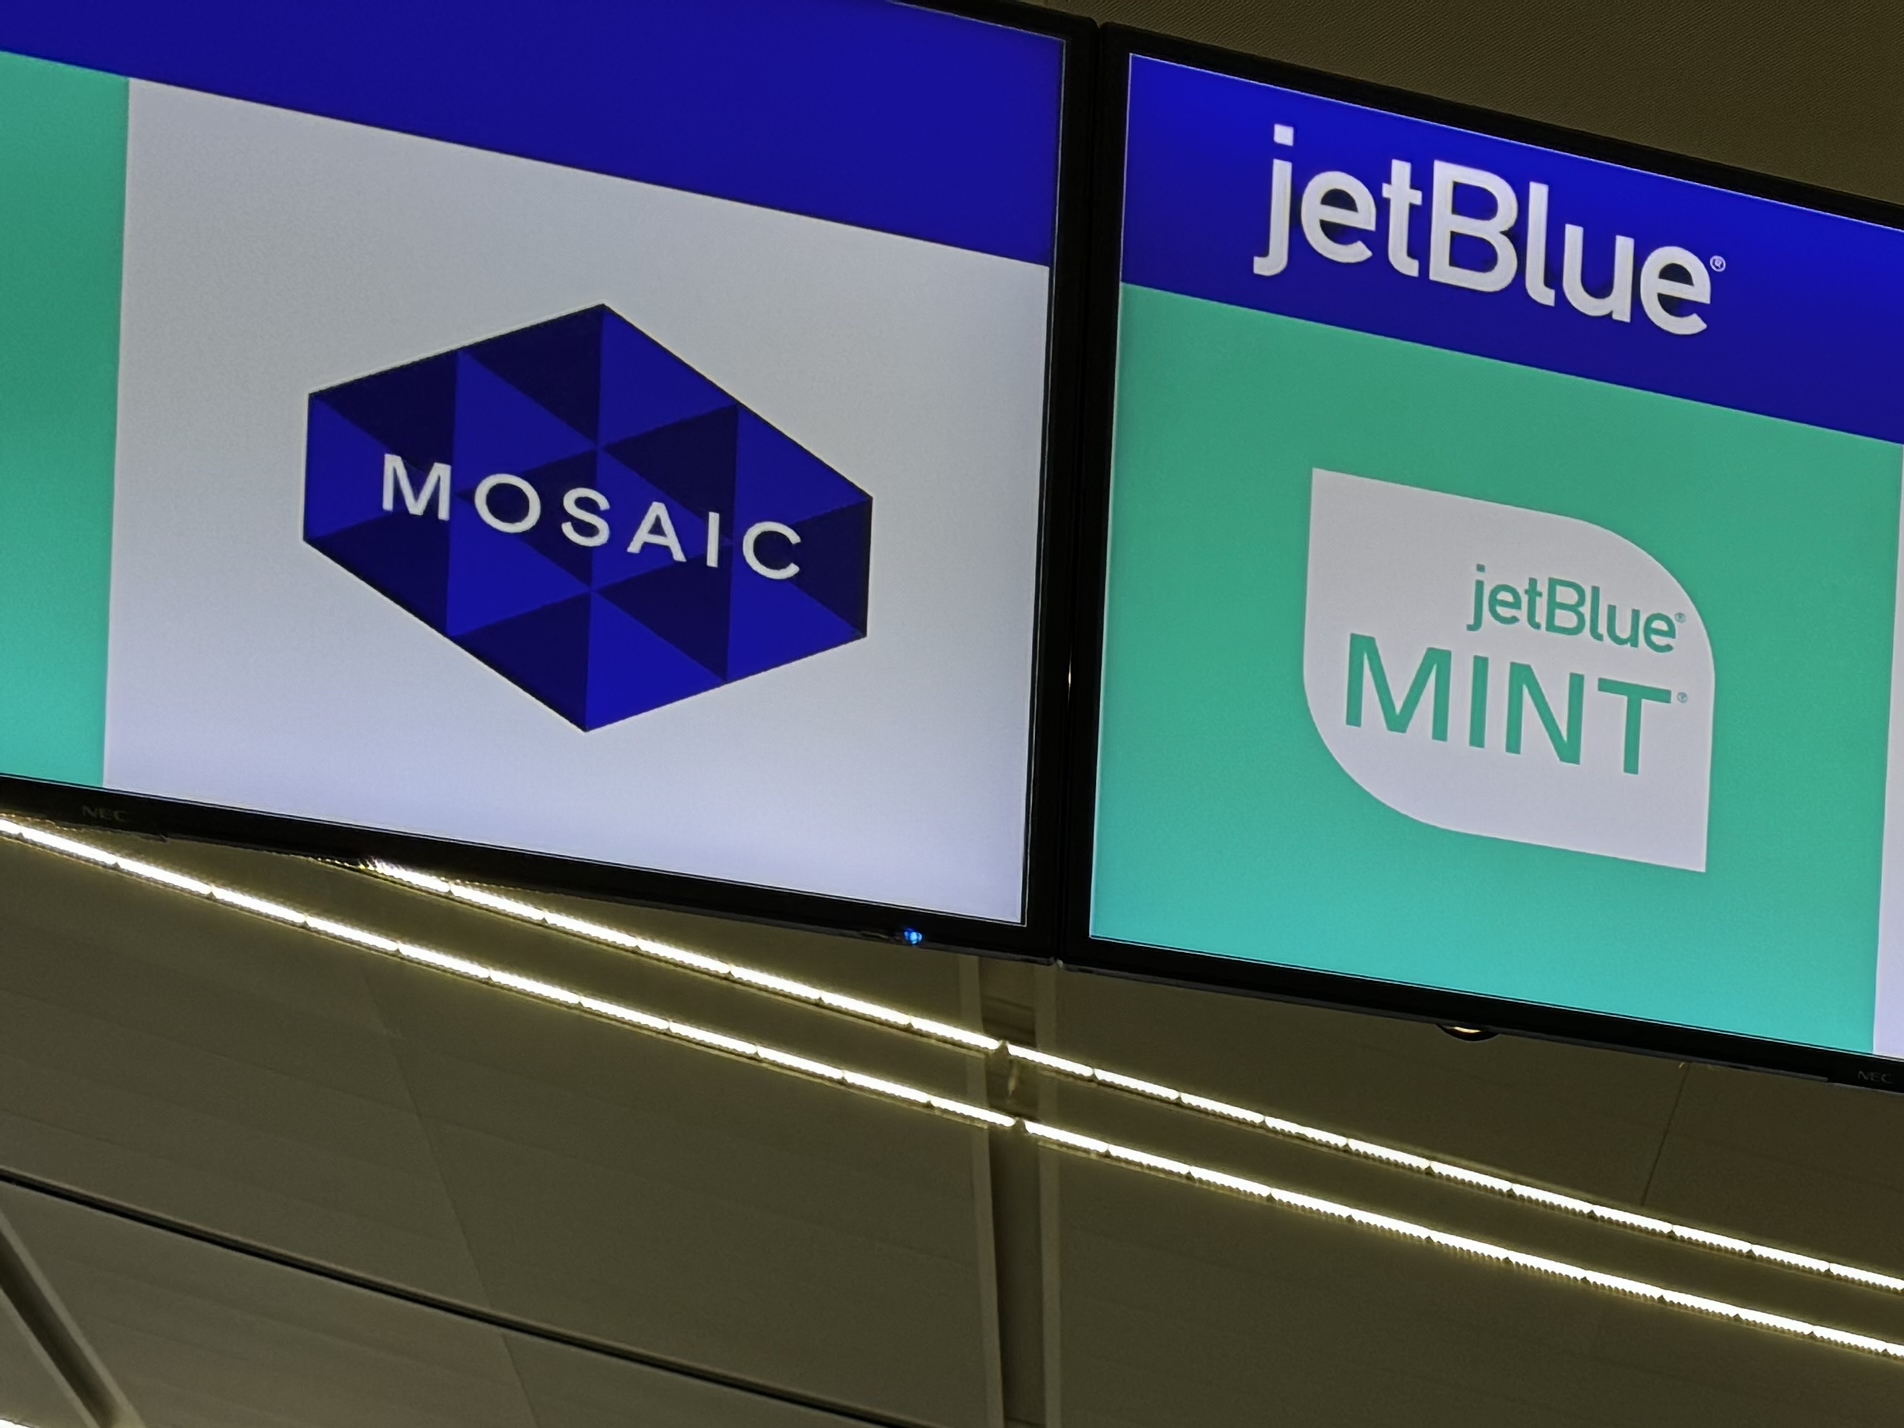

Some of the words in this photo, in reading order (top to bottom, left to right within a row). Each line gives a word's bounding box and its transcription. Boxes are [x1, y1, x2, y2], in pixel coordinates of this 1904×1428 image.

[1253, 124, 1711, 336] jetBlue
[381, 453, 801, 579] MOSAIC
[1466, 563, 1676, 653] jetBlue
[1346, 632, 1672, 775] MINT
